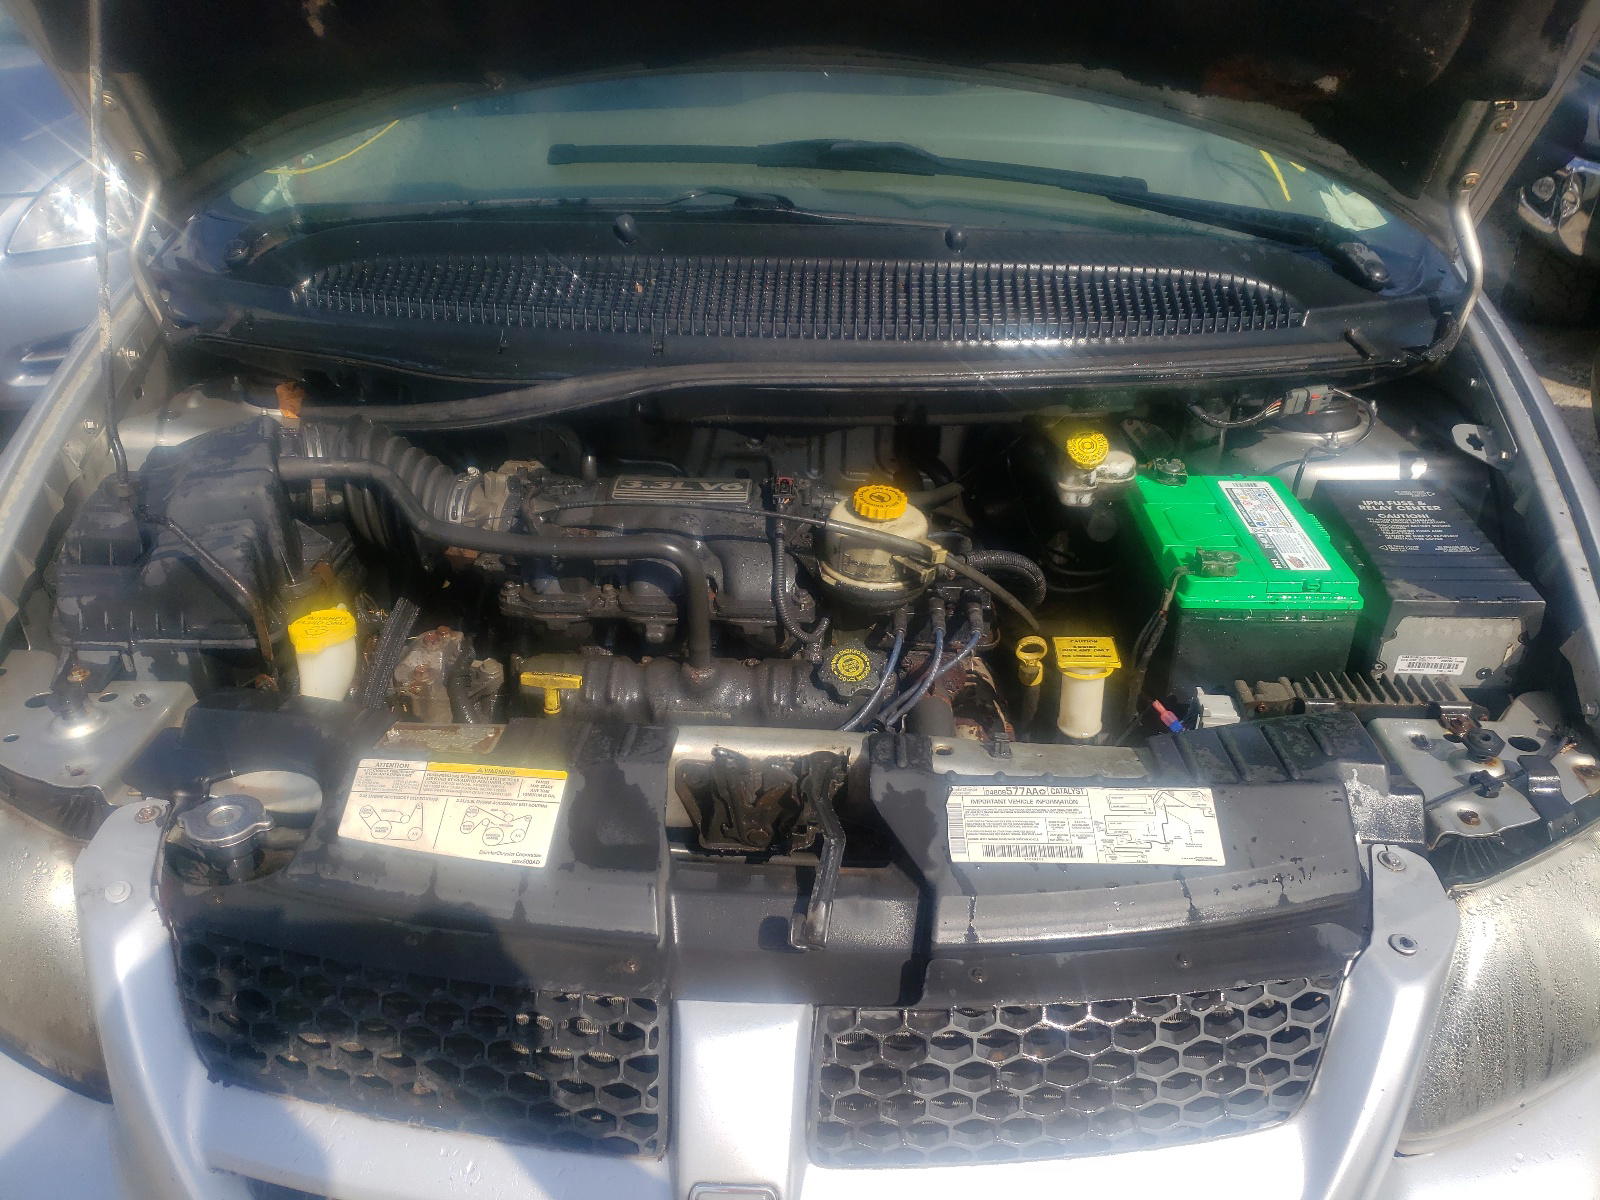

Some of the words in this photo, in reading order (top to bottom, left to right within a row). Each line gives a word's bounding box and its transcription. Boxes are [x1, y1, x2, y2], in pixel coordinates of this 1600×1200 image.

[620, 480, 693, 490] 3.3L
[700, 482, 745, 491] V6
[1050, 787, 1085, 796] CATALYST
